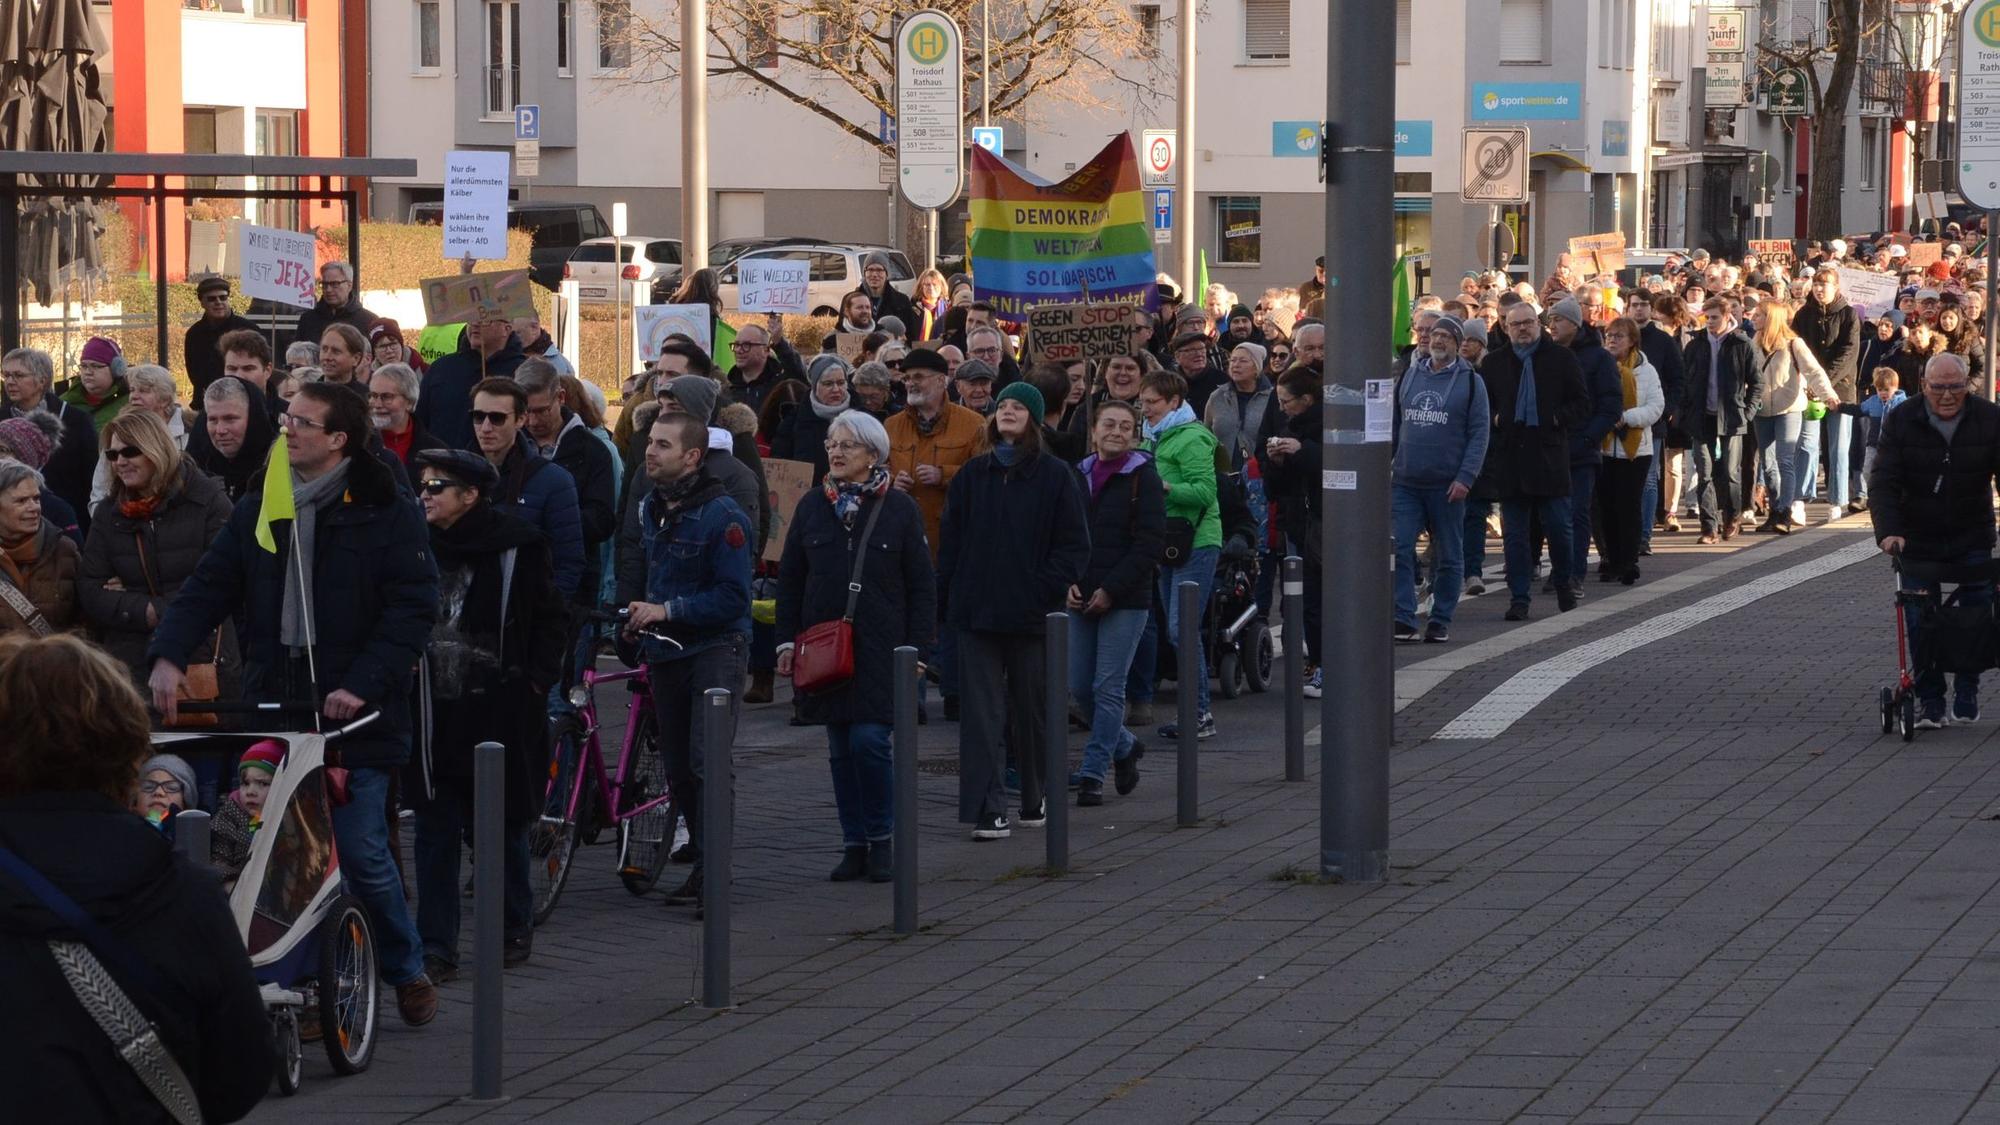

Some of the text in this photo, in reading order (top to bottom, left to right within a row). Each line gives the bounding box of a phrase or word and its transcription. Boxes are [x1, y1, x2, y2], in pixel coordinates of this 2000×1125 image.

[1978, 51, 2000, 60] Trois
[912, 67, 944, 76] Troisdorf
[1979, 61, 2000, 72] Rath
[913, 78, 942, 86] Rathaus
[1500, 95, 1569, 106] sportwetten.de
[1974, 107, 1989, 115] 507
[913, 128, 927, 136] 508
[1155, 147, 1167, 162] 30
[1484, 148, 1506, 168] 20
[451, 165, 476, 173] Nur die
[451, 177, 503, 185] allerdümmsten
[1153, 174, 1168, 182] ZONE
[450, 189, 472, 197] Kälber
[1479, 184, 1508, 195] ZONE
[450, 213, 475, 221] wählen
[448, 225, 485, 233] Schlächter
[248, 231, 313, 260] NIE WIEDER
[448, 236, 470, 245] selber
[475, 237, 489, 245] AfD
[1772, 241, 1790, 253] BIN
[248, 261, 272, 281] IST
[740, 268, 804, 284] NIE WIEDER
[742, 286, 808, 305] IST JETZT!
[1030, 305, 1131, 327] GEGEN STOP
[1032, 324, 1137, 353] RECHTSEXTREM-
[1039, 340, 1132, 360] STOP ISMUS!
[1404, 408, 1449, 425] SPIEKEROOG
